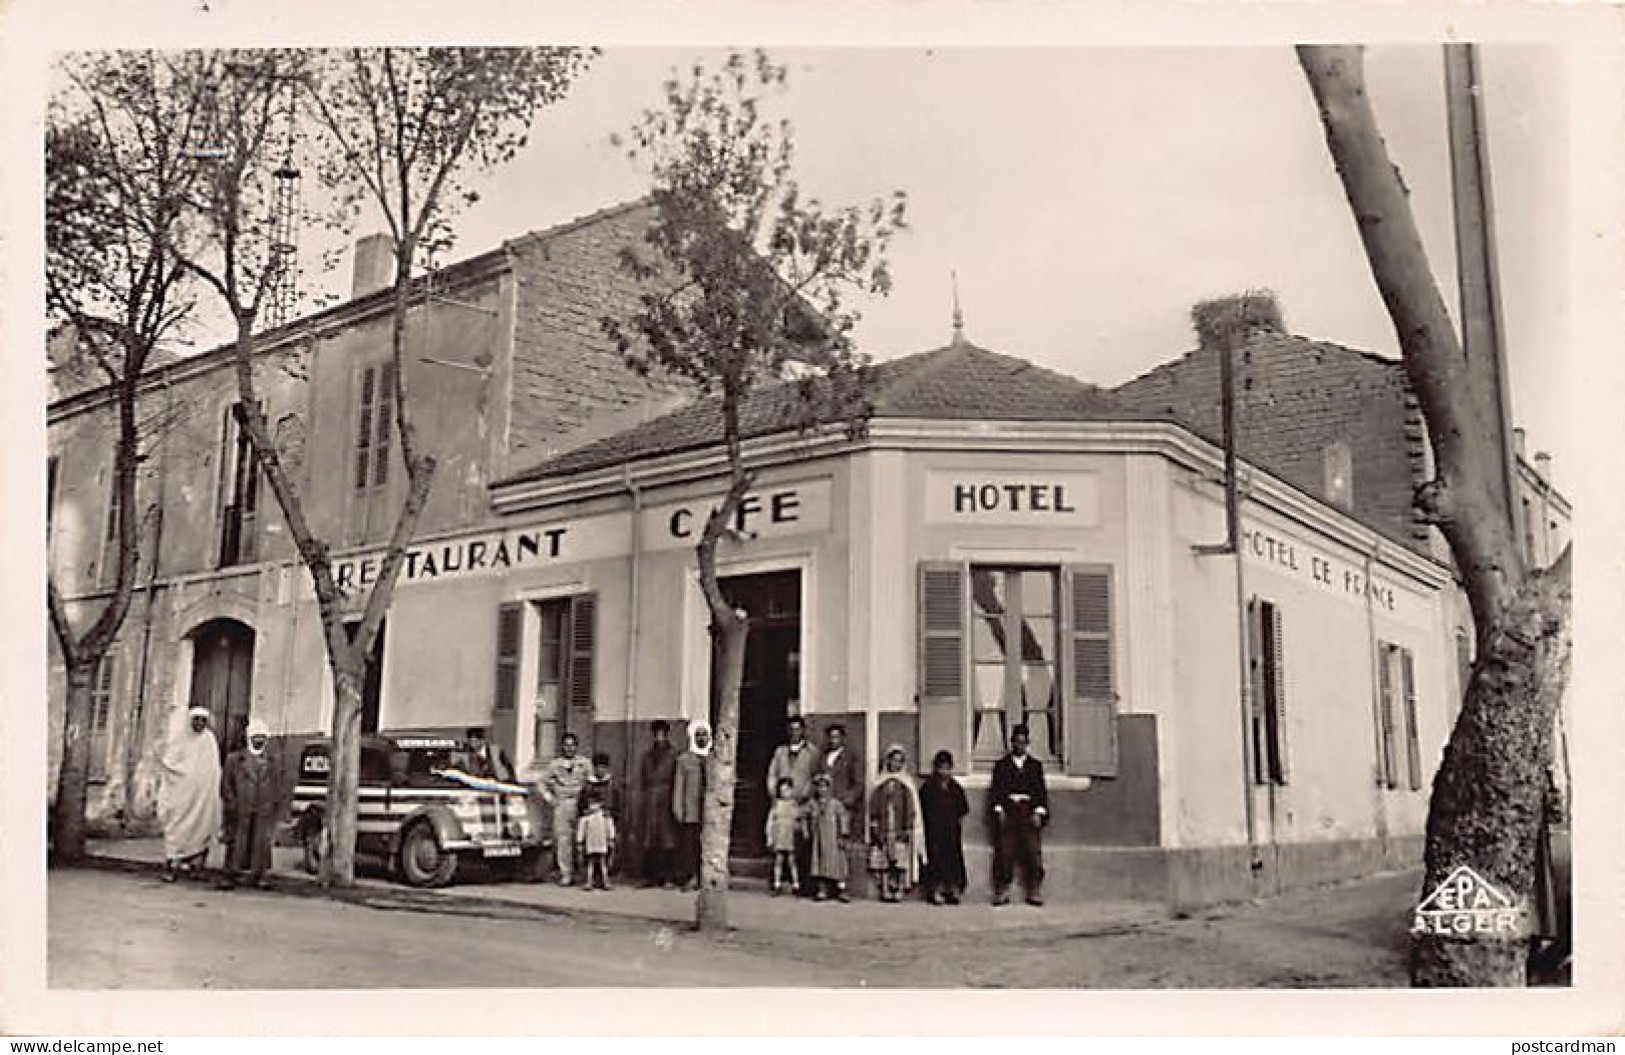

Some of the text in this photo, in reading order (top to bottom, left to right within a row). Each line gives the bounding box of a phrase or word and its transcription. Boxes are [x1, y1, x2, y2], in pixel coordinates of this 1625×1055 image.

[669, 491, 801, 538] CFE
[955, 484, 1075, 513] HOTEL
[338, 529, 566, 586] RETAURANT
